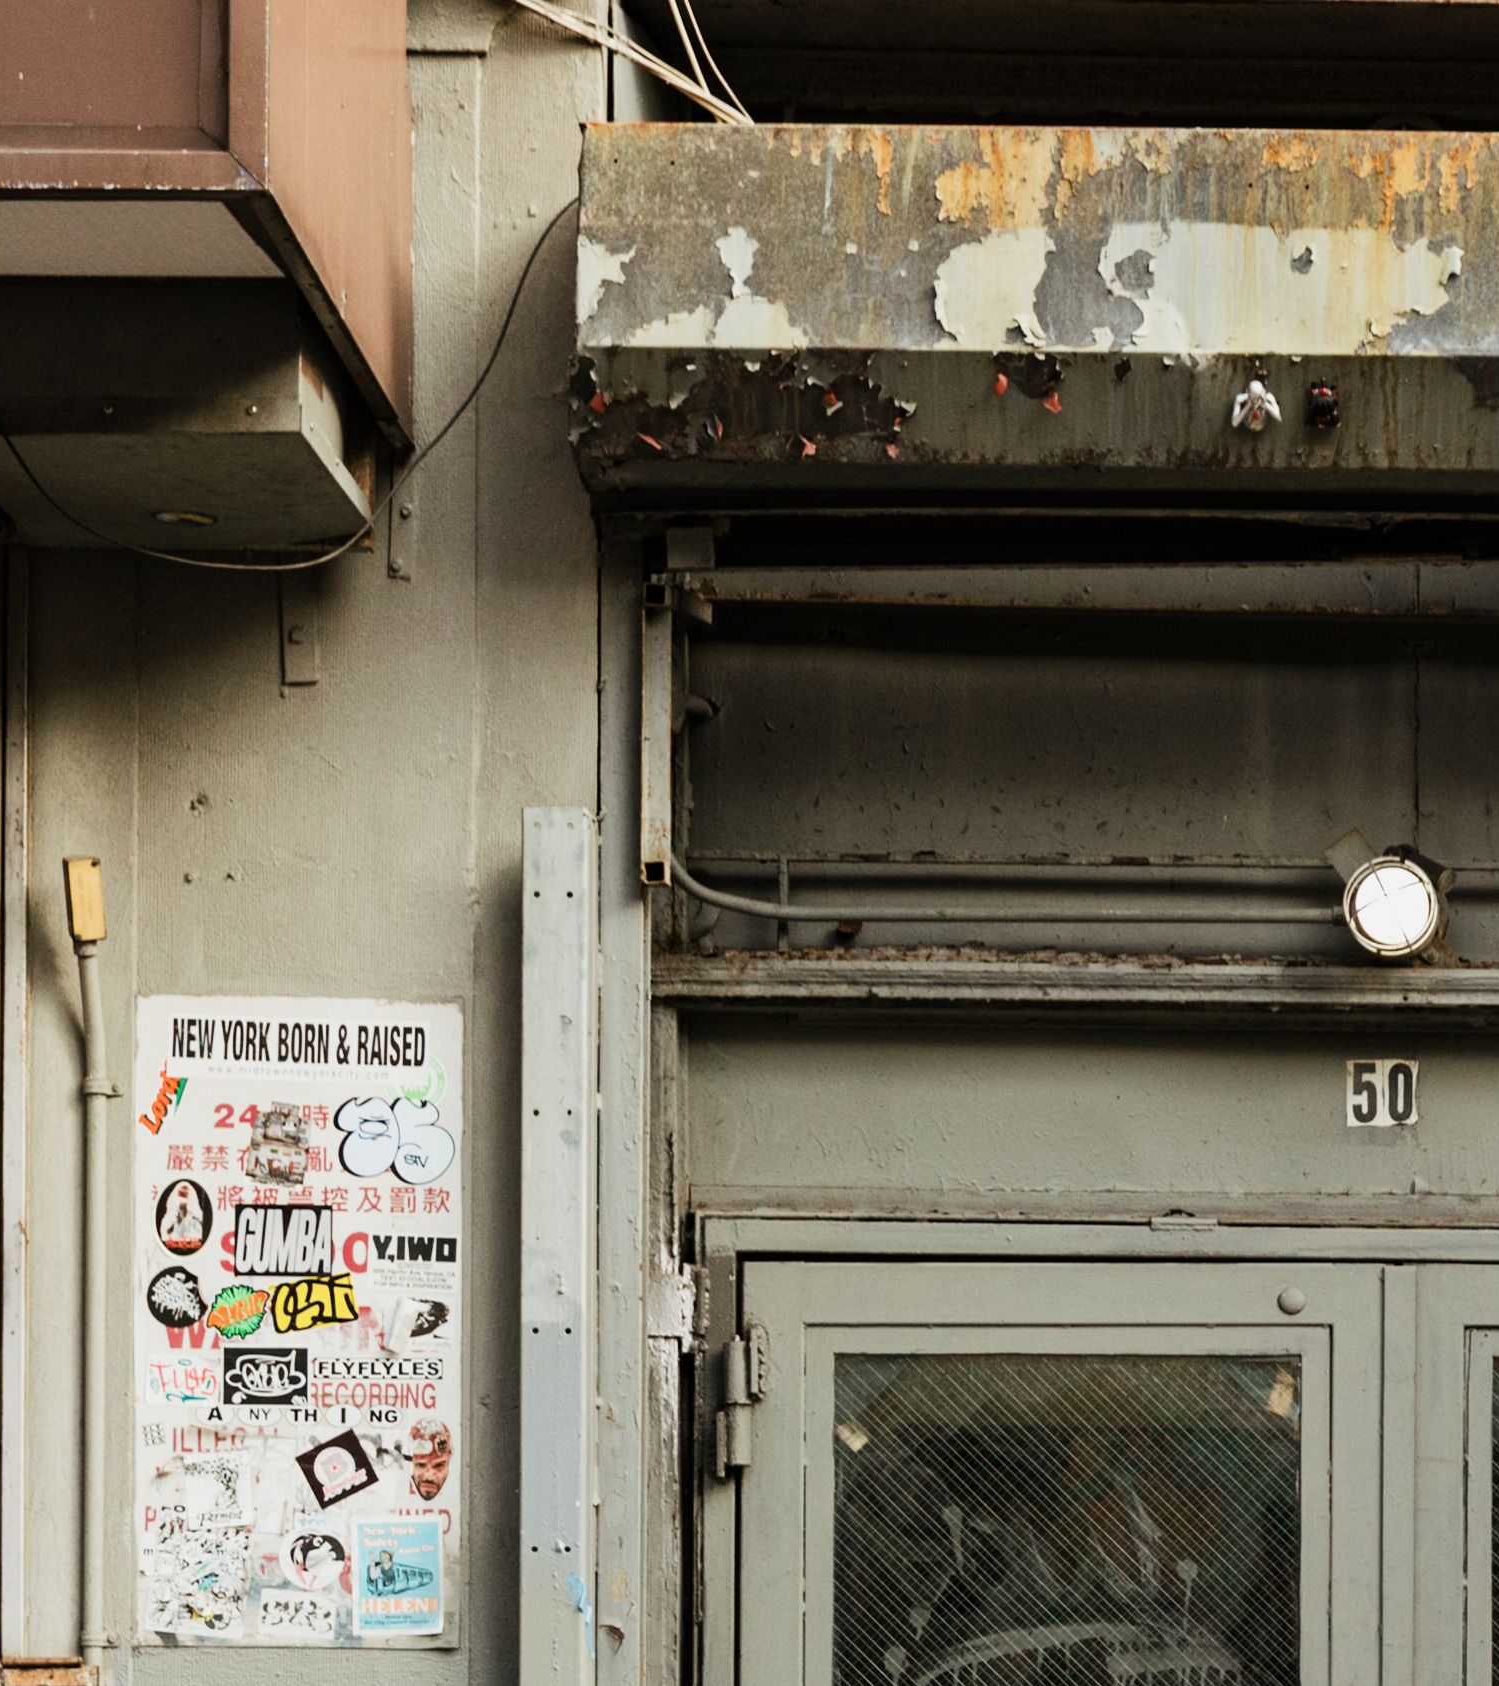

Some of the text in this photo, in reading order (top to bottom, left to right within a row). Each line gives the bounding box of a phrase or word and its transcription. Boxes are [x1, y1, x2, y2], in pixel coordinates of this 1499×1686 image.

[172, 1018, 426, 1067] NEW YORK BORN & RAISED
[1352, 1062, 1414, 1124] 50
[238, 1207, 331, 1274] GUMBA
